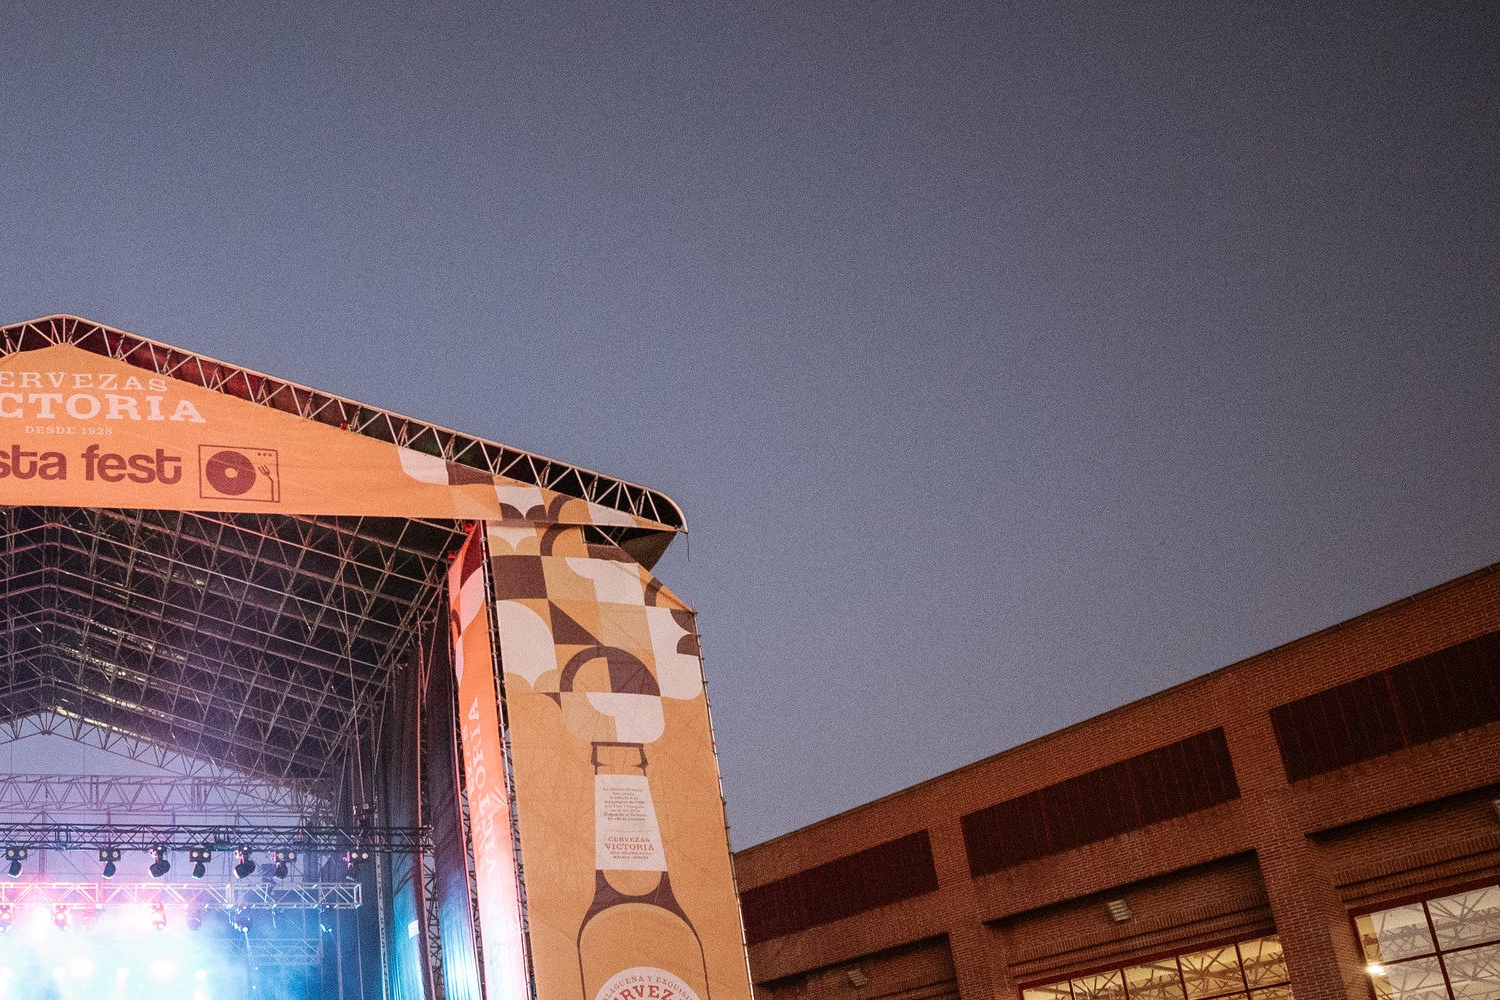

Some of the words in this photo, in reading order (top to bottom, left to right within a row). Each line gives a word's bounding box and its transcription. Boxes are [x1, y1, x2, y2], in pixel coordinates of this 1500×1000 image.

[25, 426, 77, 435] DESDE
[80, 426, 113, 436] 1928
[80, 445, 183, 485] fest
